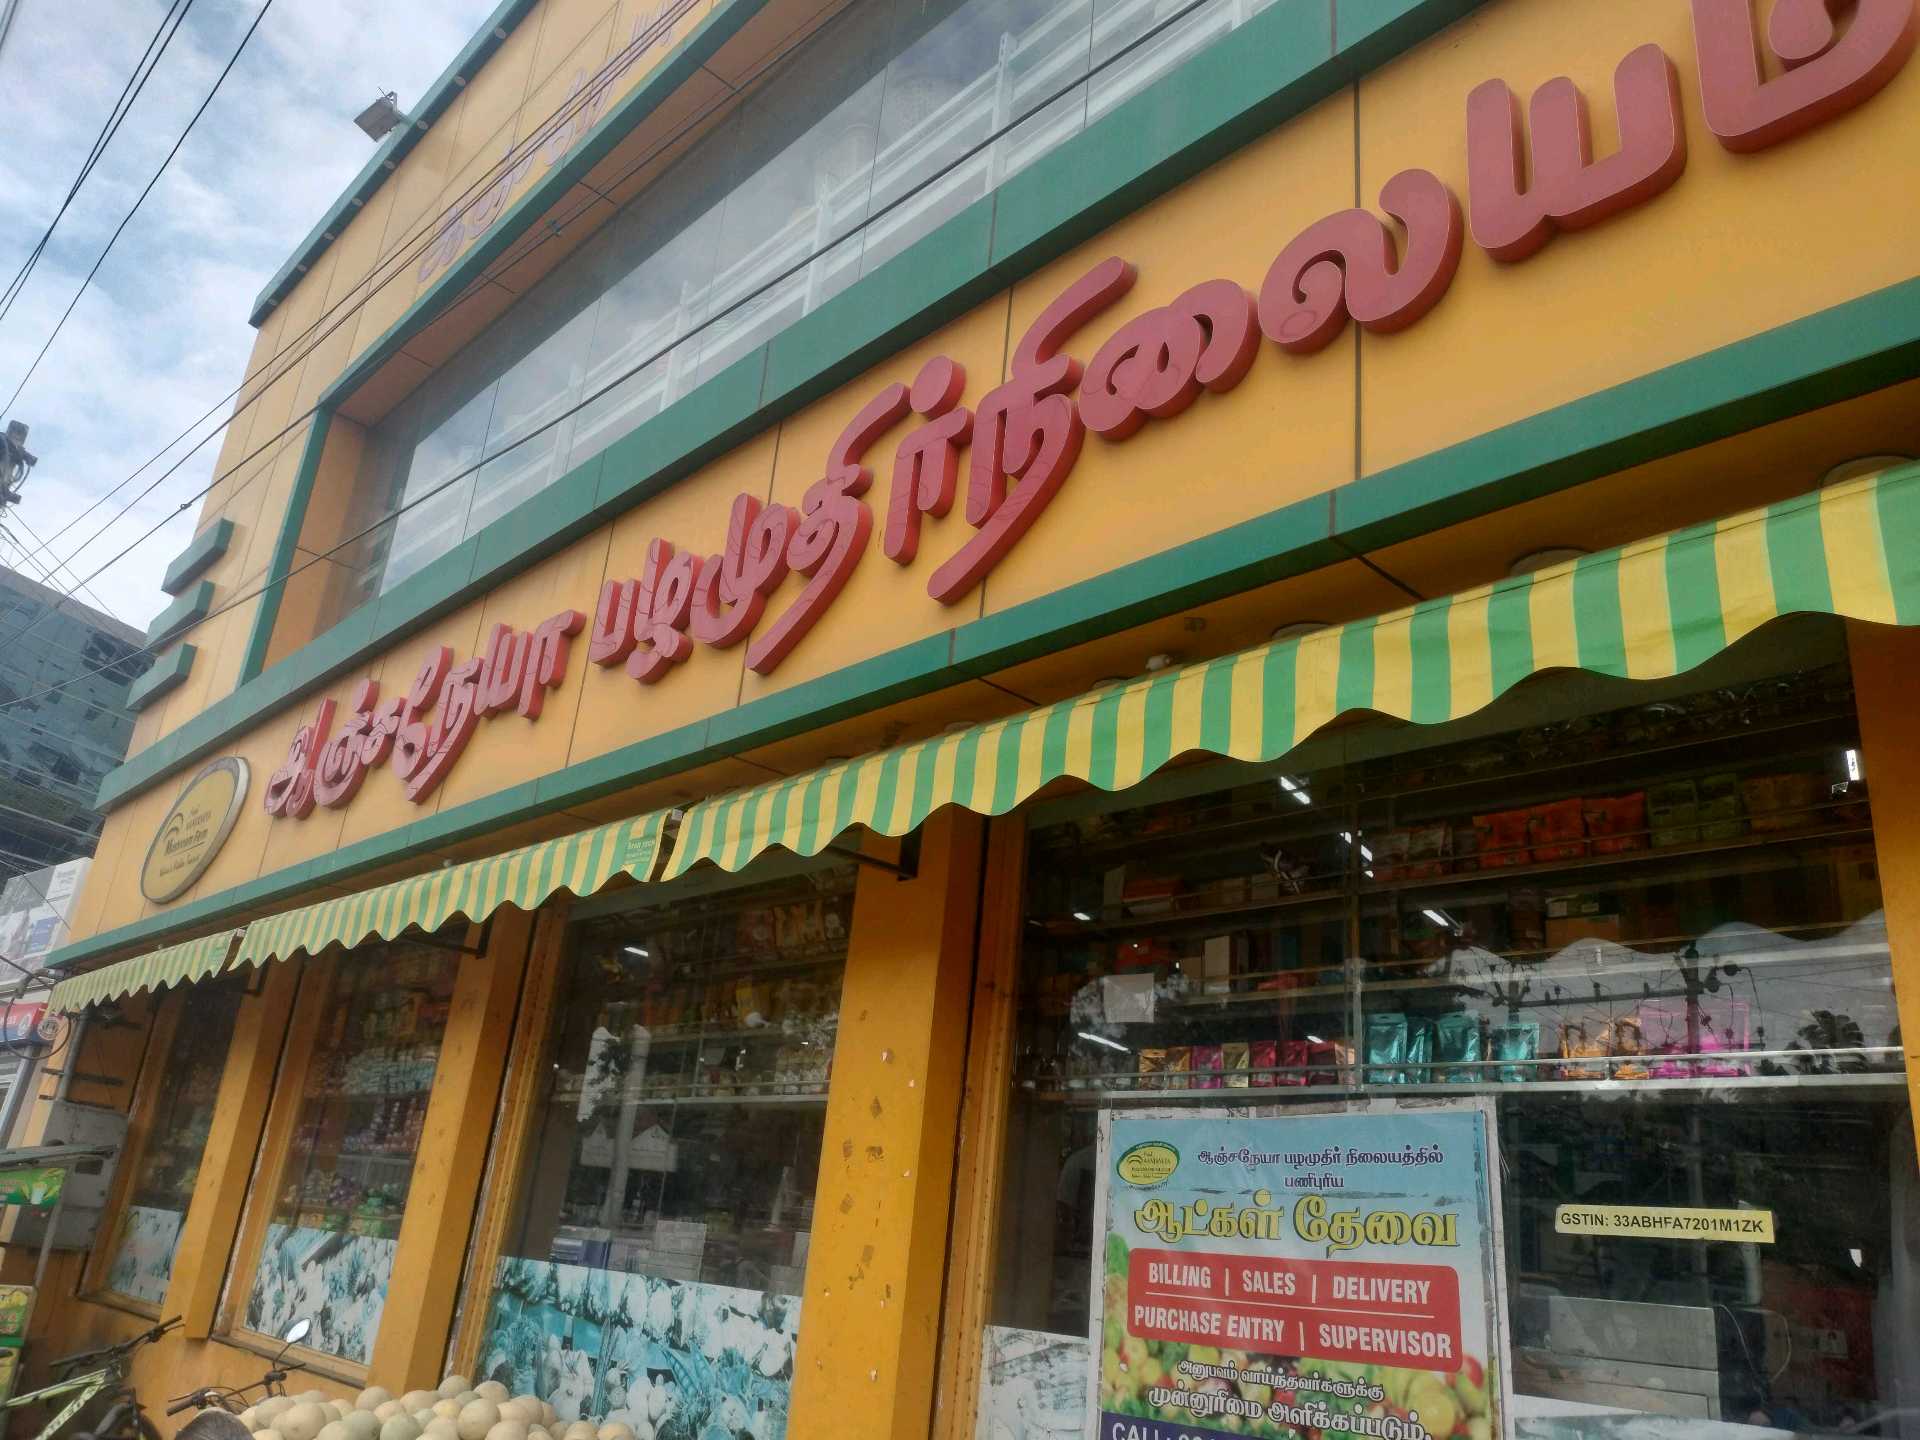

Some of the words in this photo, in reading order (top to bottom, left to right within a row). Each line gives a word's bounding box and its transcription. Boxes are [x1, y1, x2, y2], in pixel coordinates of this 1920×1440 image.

[1345, 1144, 1444, 1167] நிலையத்தில்
[1284, 1172, 1345, 1190] பணிபுரிய
[1134, 1189, 1284, 1243] ஆட்கள்
[1293, 1194, 1460, 1258] தேவை
[1560, 1212, 1610, 1227] GSTIN:
[1613, 1214, 1764, 1233] 33ABHFA7201M1ZK
[1148, 1263, 1212, 1289] BILLING
[1242, 1270, 1297, 1296] SALES
[1332, 1275, 1431, 1304] DELIVERY
[1134, 1305, 1221, 1335] PURCHASE
[1226, 1315, 1285, 1343] ENTRY
[1318, 1322, 1453, 1359] SUPERVISOR
